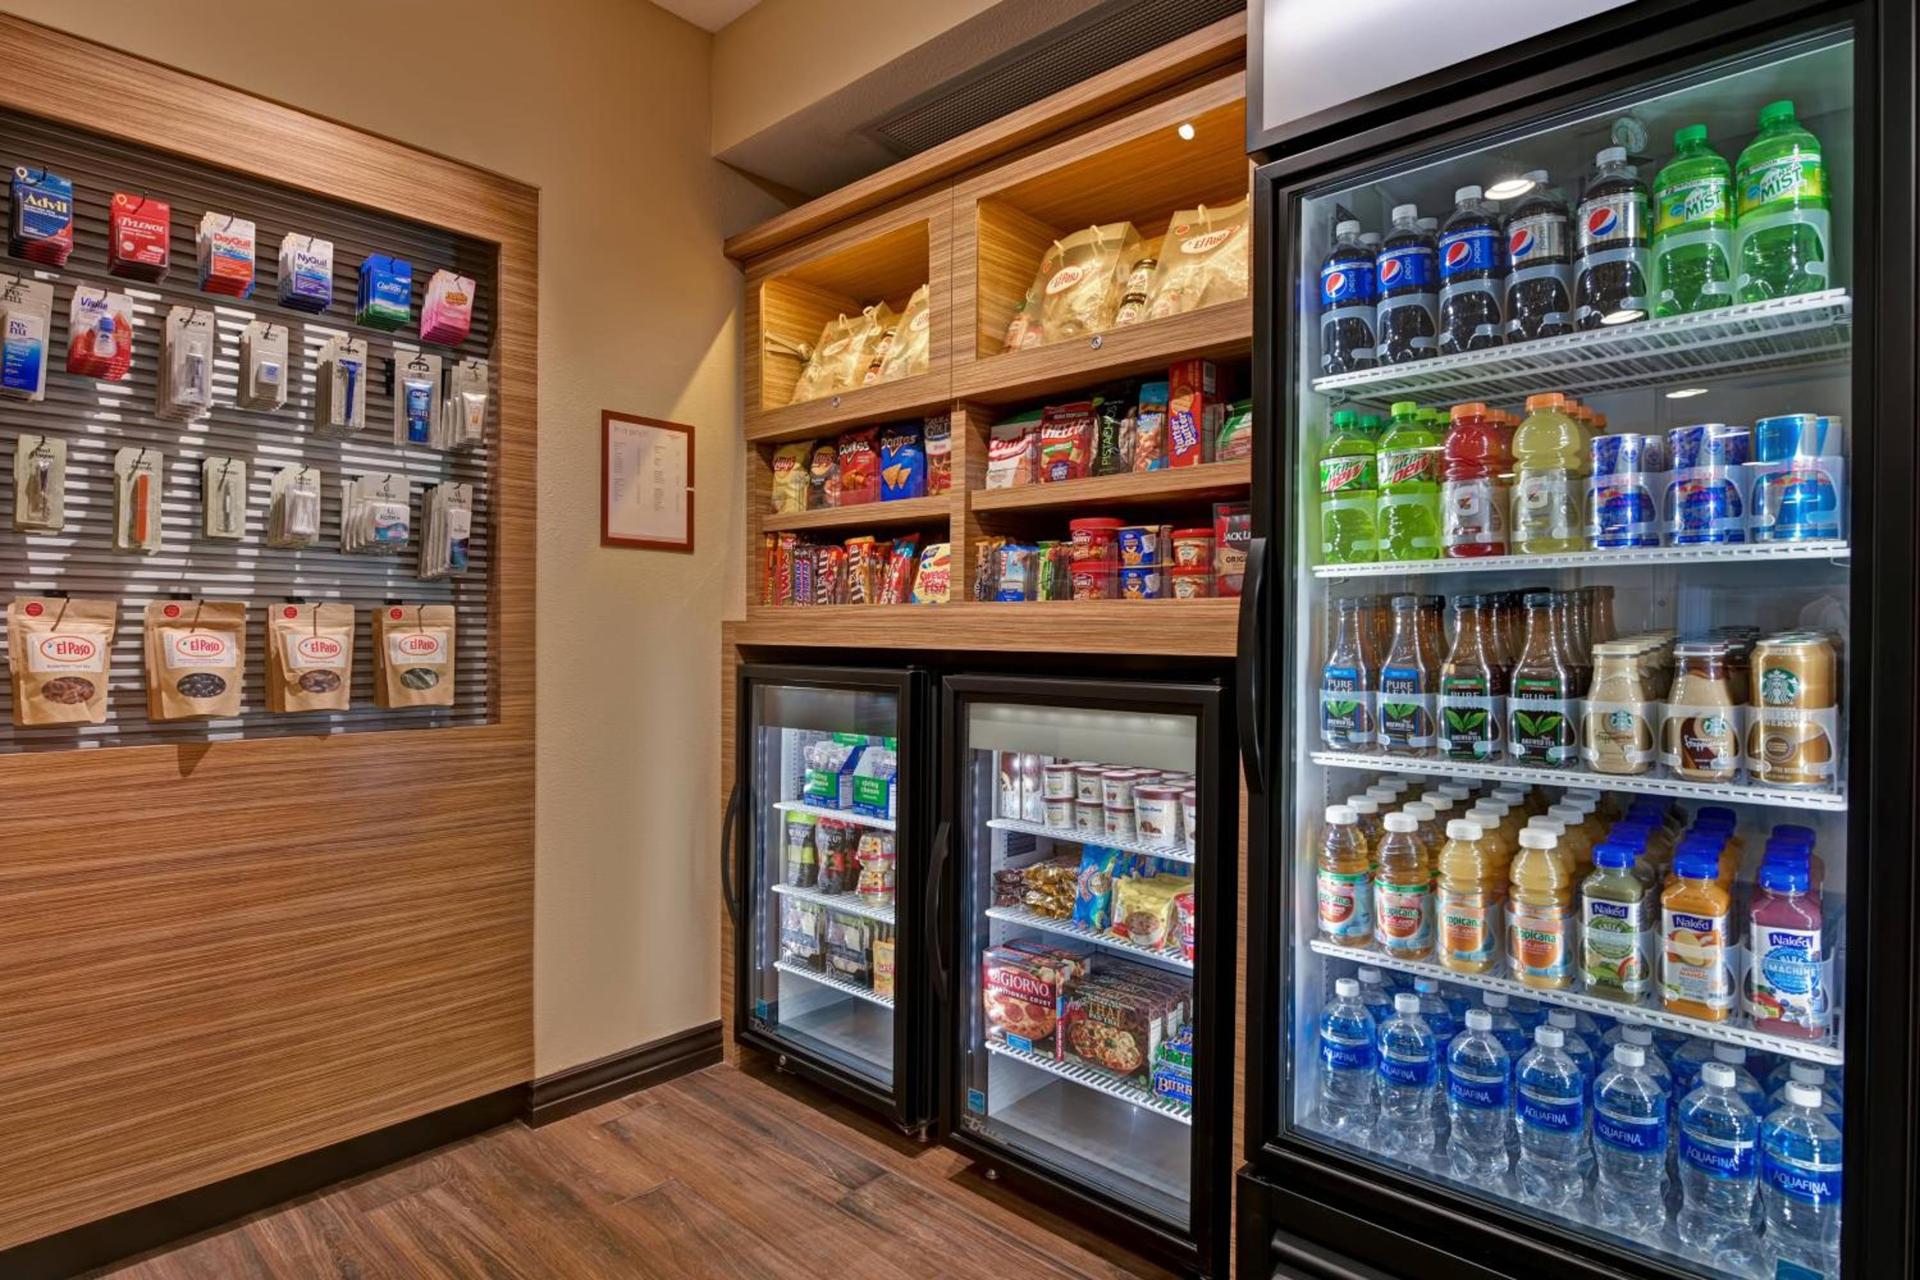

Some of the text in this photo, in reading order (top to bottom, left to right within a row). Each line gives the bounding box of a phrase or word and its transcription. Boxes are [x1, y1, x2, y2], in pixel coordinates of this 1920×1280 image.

[1761, 167, 1802, 203] MIST
[23, 193, 68, 214] Advil
[1685, 190, 1721, 220] MIST
[121, 217, 165, 233] TYLENOL
[297, 253, 328, 268] NyQuil
[881, 434, 917, 450] Doritos
[1222, 532, 1243, 543] JACK
[56, 641, 91, 656] El Paso
[190, 639, 220, 652] El Paso
[311, 641, 338, 654] El Paso
[410, 639, 435, 651] El Paso
[1327, 679, 1353, 691] PURE
[1386, 680, 1414, 691] PURE
[1594, 903, 1627, 919] Naked
[1676, 917, 1710, 931] Naked
[1772, 934, 1810, 948] Naked
[1322, 1046, 1359, 1065] AQUAFINA
[1380, 1061, 1417, 1082] AQUAFINA
[1451, 1081, 1491, 1103] AQUAFINA
[1523, 1104, 1569, 1127] AQUAFINA
[1600, 1124, 1645, 1147] AQUAFINA
[1686, 1145, 1740, 1172] AQUAFINA
[1773, 1170, 1833, 1197] AQUAFINA
